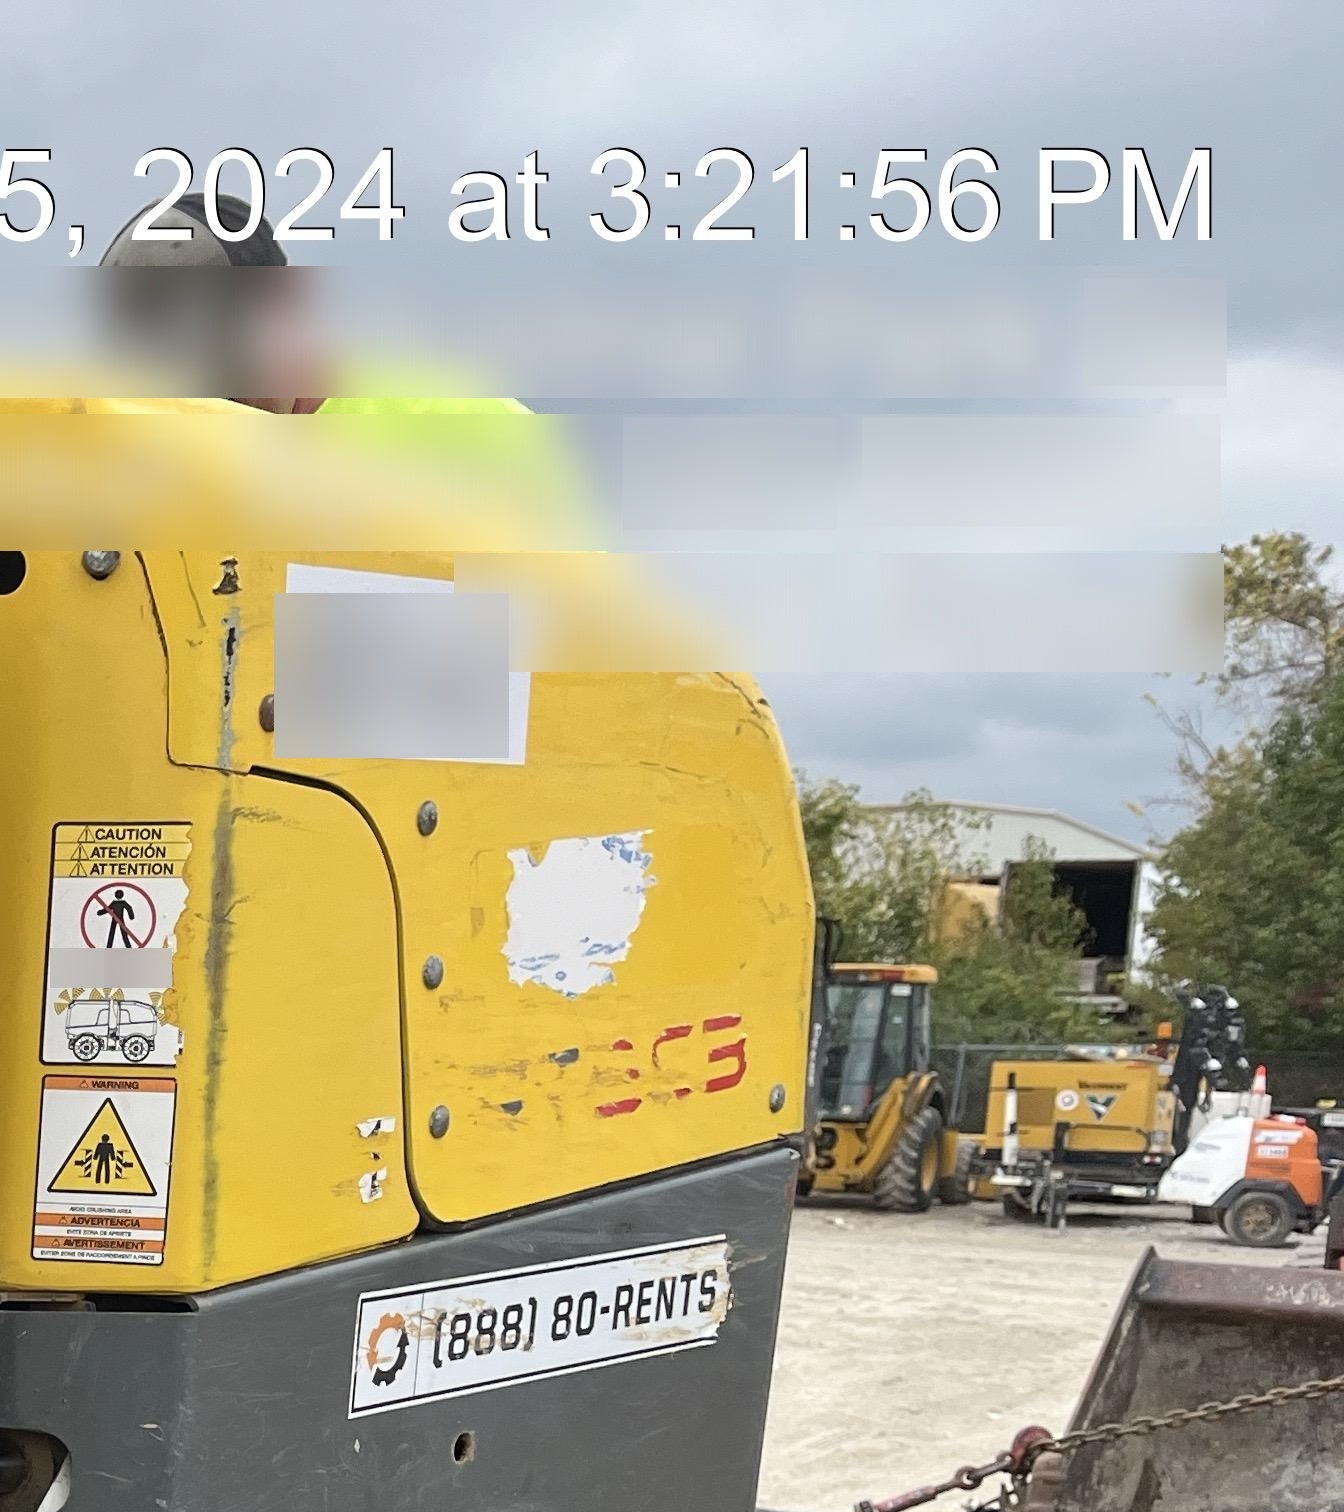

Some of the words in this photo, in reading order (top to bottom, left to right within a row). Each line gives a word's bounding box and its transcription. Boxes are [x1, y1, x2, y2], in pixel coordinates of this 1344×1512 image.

[94, 828, 162, 841] CAUTION
[90, 843, 166, 859] ATENCIÓN
[90, 862, 174, 876] ATTENTION
[92, 1080, 140, 1090] WARNING
[70, 1216, 141, 1228] ADVERTENCIA
[63, 1239, 146, 1250] AVERTISSEMENT
[434, 1297, 537, 1368] (888)
[552, 1269, 718, 1342] 80-RENTS
